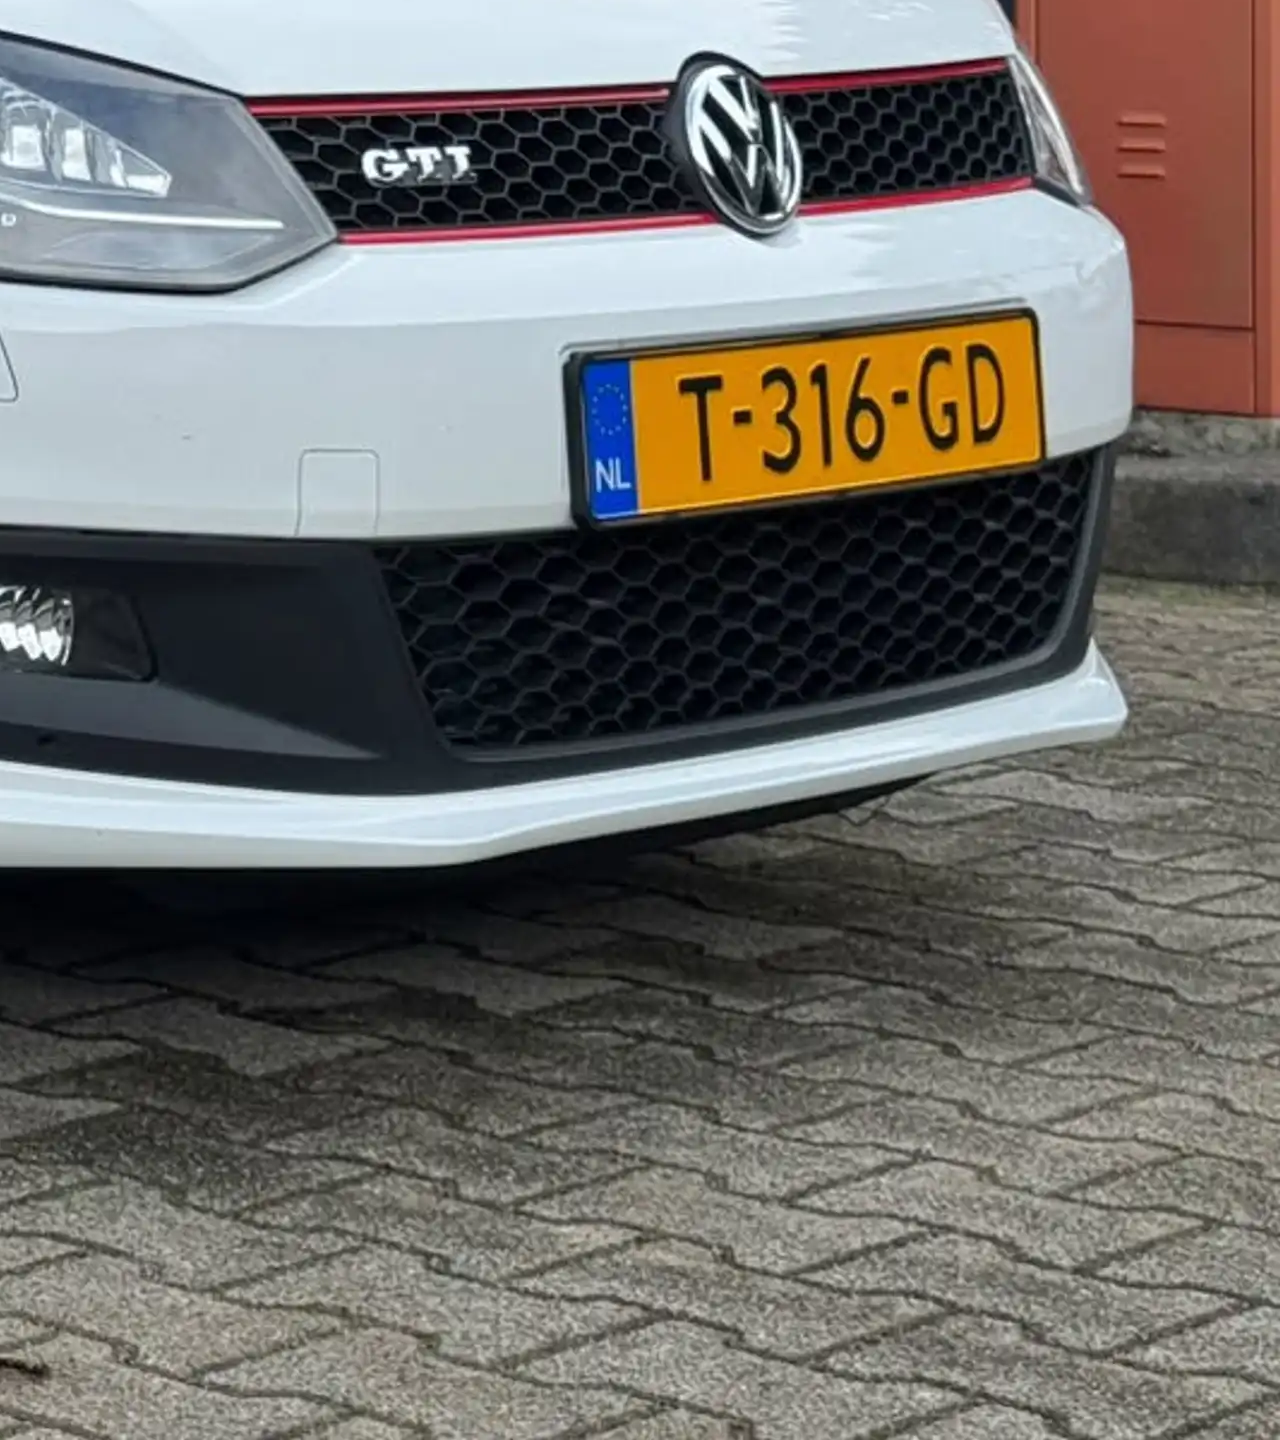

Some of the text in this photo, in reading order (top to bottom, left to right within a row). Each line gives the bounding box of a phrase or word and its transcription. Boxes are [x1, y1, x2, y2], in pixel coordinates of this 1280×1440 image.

[361, 146, 476, 185] GTI
[678, 342, 1006, 482] T-316-GD
[594, 457, 632, 492] NL
